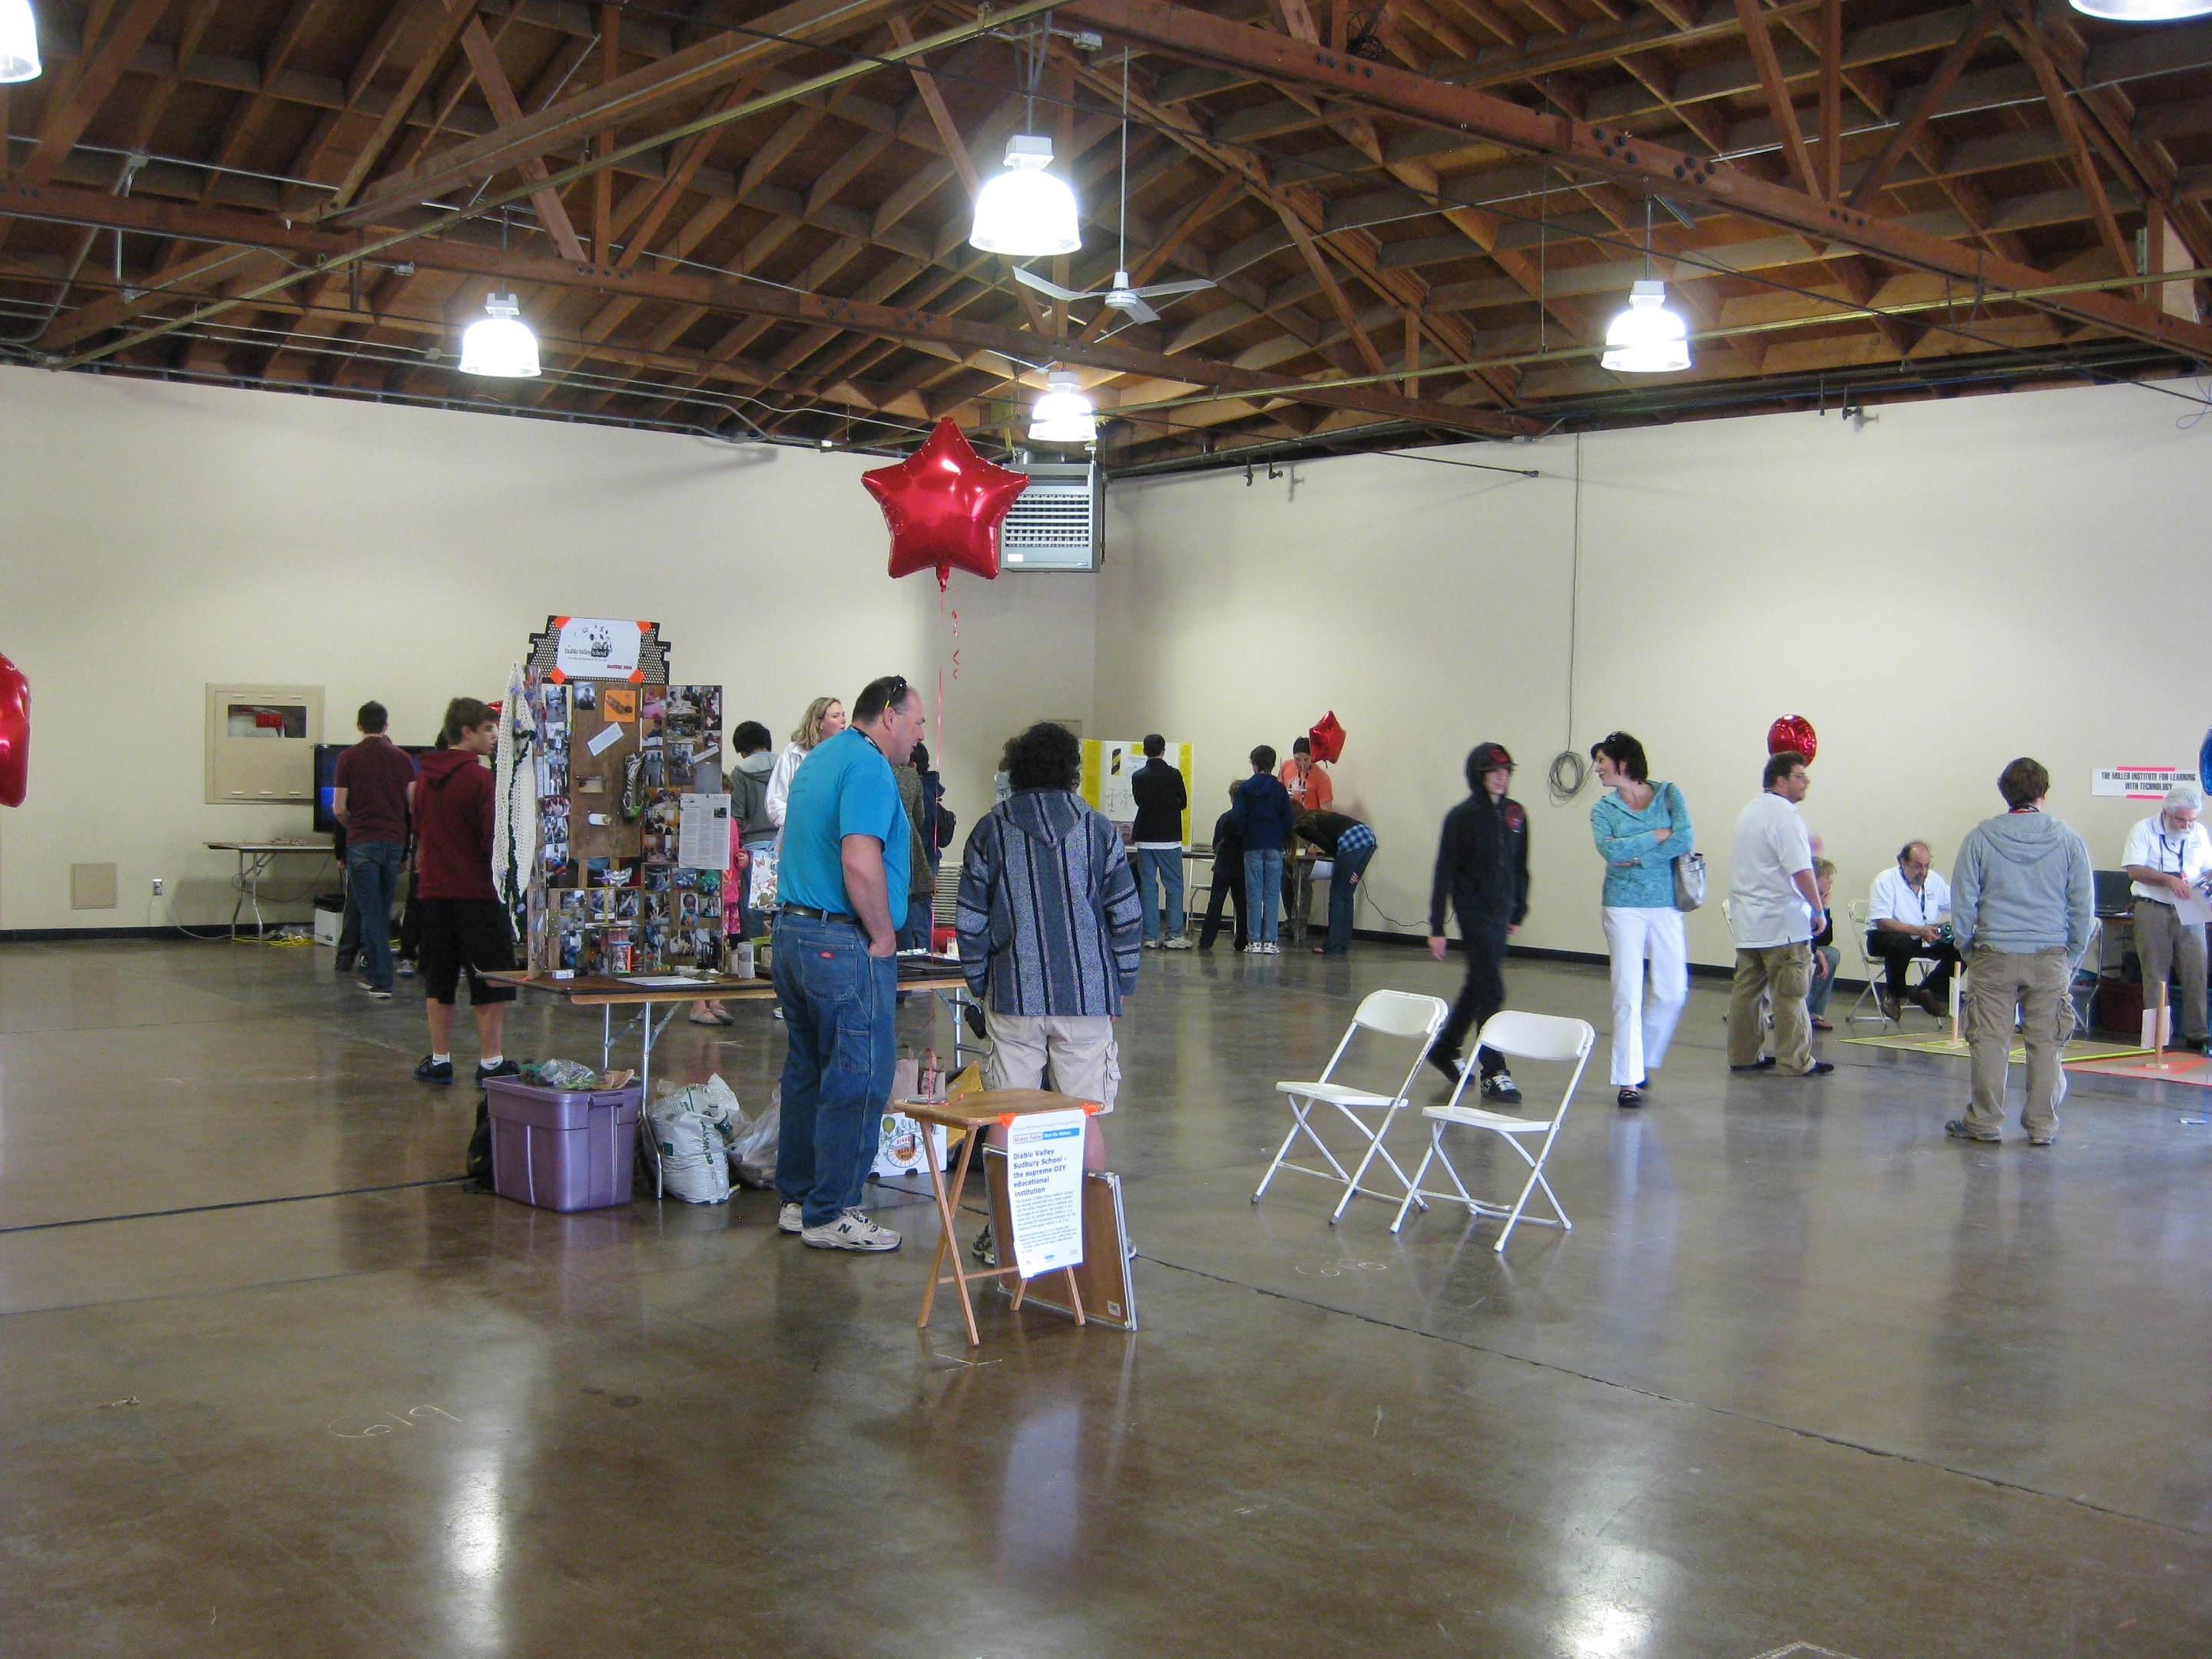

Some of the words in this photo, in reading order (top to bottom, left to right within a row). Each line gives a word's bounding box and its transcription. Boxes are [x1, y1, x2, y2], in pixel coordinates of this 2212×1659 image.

[2112, 772, 2130, 780] MILLER
[2131, 773, 2157, 781] INSTITUTE
[2171, 773, 2195, 782] LEARNING
[2141, 783, 2172, 791] TECHNOLOGY
[1014, 1151, 1034, 1160] Diablo
[1035, 1148, 1055, 1157] Valley
[1014, 1161, 1040, 1169] Sudbury
[1041, 1156, 1063, 1165] School
[1025, 1167, 1052, 1177] supreme
[1014, 1176, 1050, 1187] educational
[1015, 1187, 1045, 1197] institution
